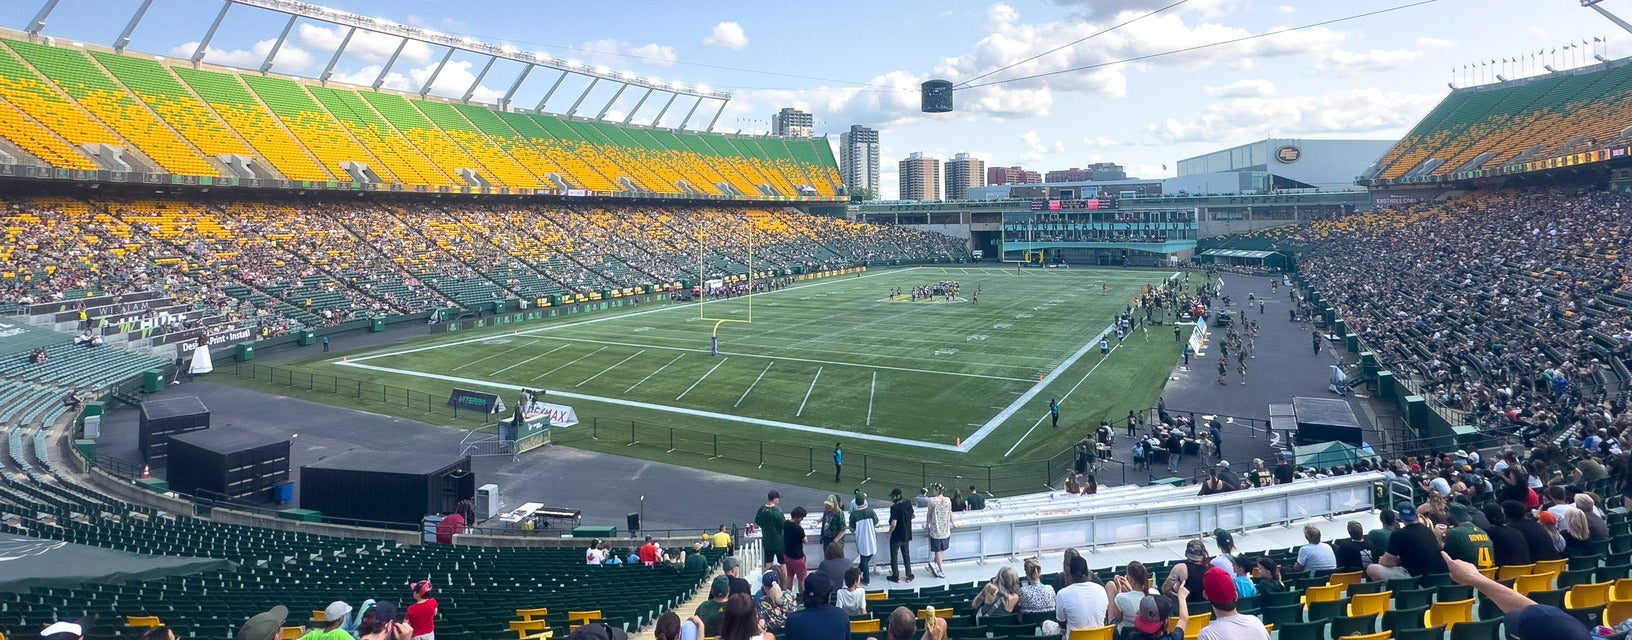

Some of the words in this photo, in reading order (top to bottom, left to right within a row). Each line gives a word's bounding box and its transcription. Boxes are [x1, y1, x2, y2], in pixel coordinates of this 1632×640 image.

[1125, 221, 1192, 231] STADIUM
[209, 334, 226, 346] Print
[229, 328, 251, 341] Install
[1478, 547, 1493, 567] 4
